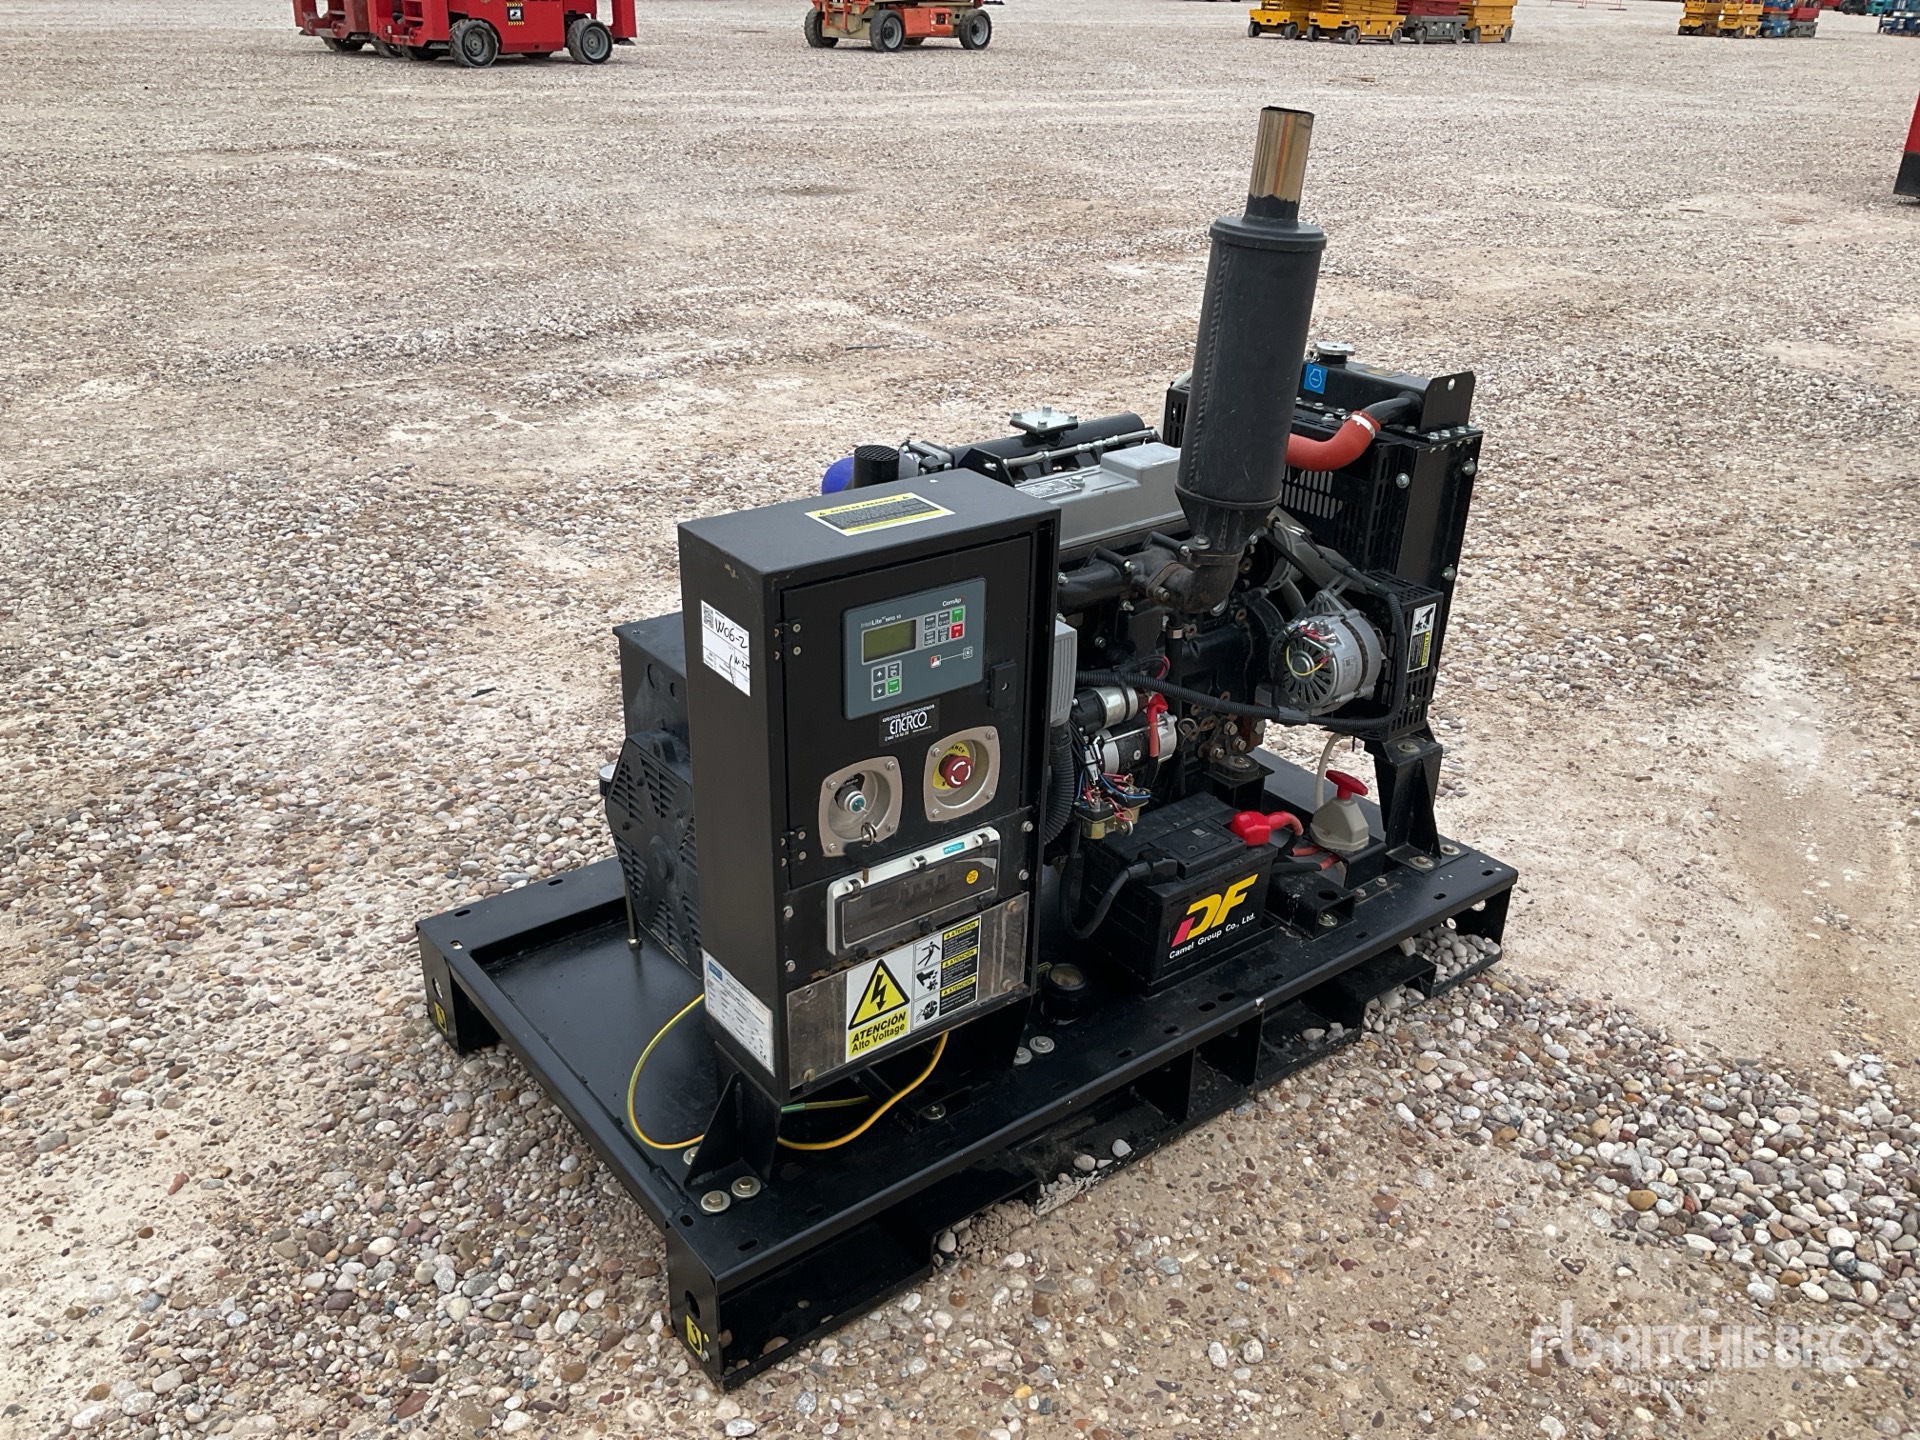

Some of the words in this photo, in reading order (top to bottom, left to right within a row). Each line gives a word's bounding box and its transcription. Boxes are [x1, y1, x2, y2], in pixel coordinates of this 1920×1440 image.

[889, 711, 928, 735] ENERCO
[1169, 941, 1195, 959] Camel
[1197, 929, 1222, 946] Group
[1241, 912, 1256, 925] Ltd.
[851, 1011, 907, 1044] ATENCIÓN
[851, 1038, 871, 1053] Alto
[872, 1022, 905, 1043] Voltage
